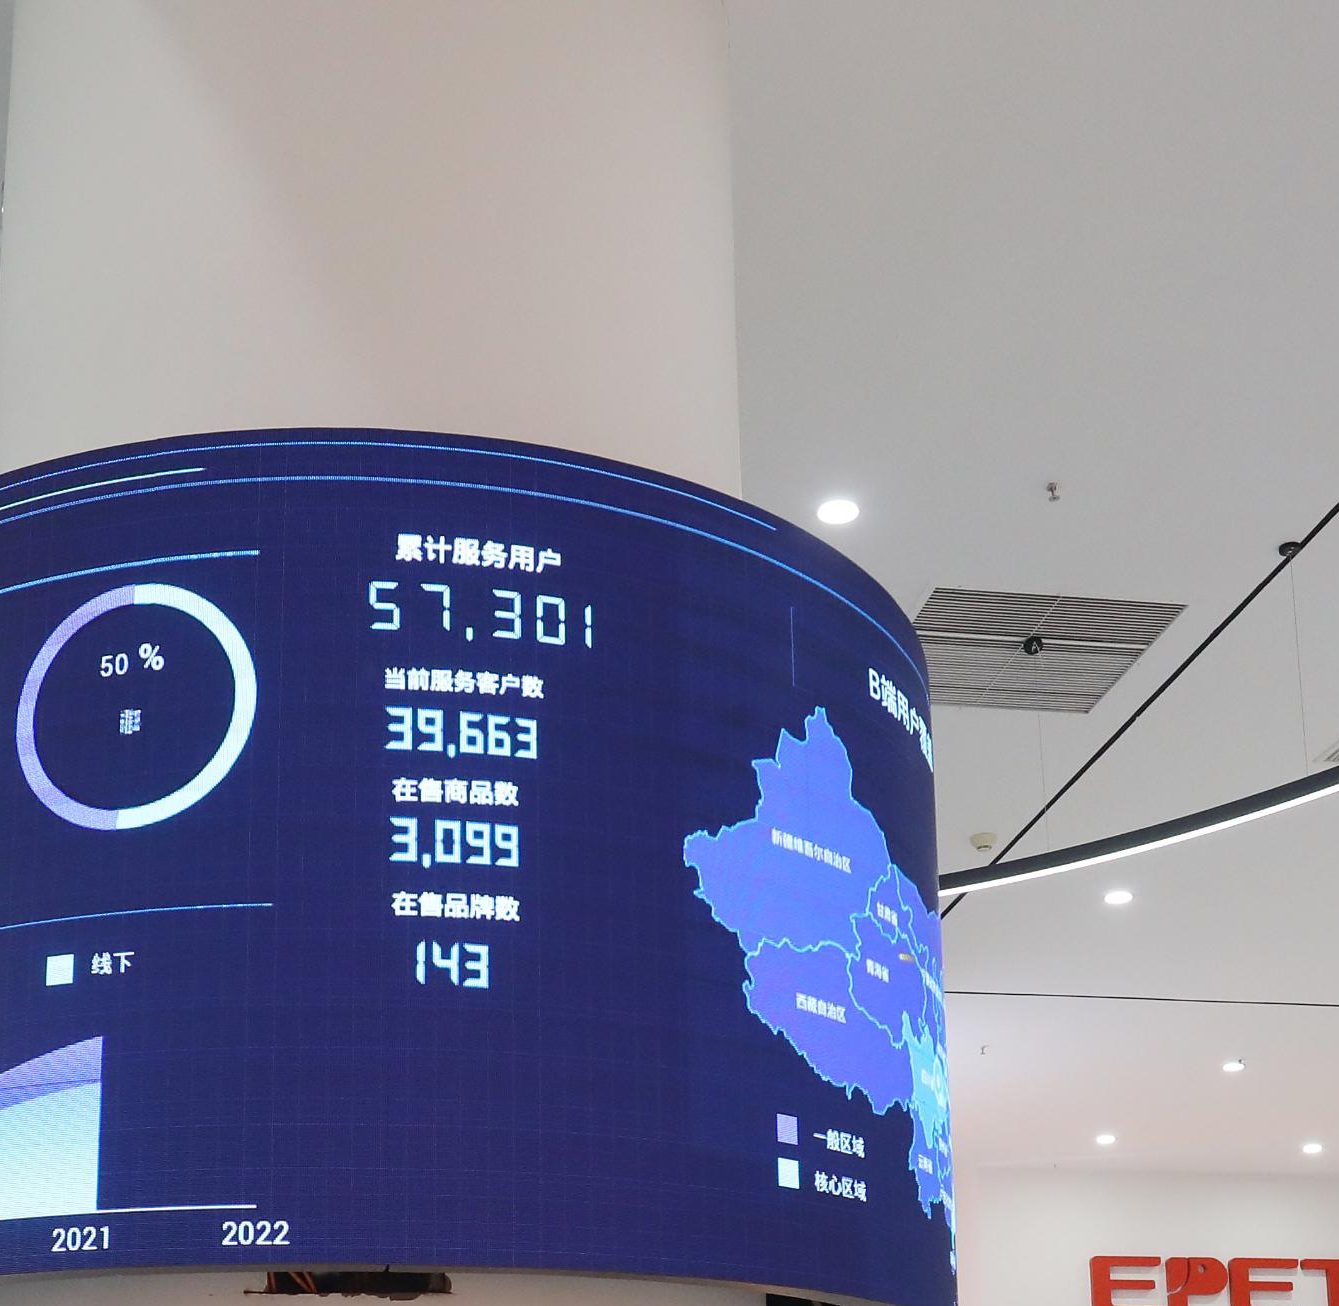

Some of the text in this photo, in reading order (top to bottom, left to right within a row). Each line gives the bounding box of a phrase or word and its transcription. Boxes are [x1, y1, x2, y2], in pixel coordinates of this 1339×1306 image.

[395, 533, 562, 573] 累计服务用户
[99, 643, 164, 678] 50 %
[384, 667, 544, 699] 当前服务客户数
[384, 706, 538, 759] 39,663
[391, 777, 519, 806] 在售商品数
[389, 816, 519, 869] 3,099
[391, 891, 520, 922] 在售品牌数
[91, 951, 135, 975] 线下
[416, 939, 489, 989] 143
[813, 1128, 865, 1158] 一般区域
[814, 1170, 867, 1202] 核心区域
[51, 1225, 110, 1253] 2021
[221, 1220, 290, 1247] 2022
